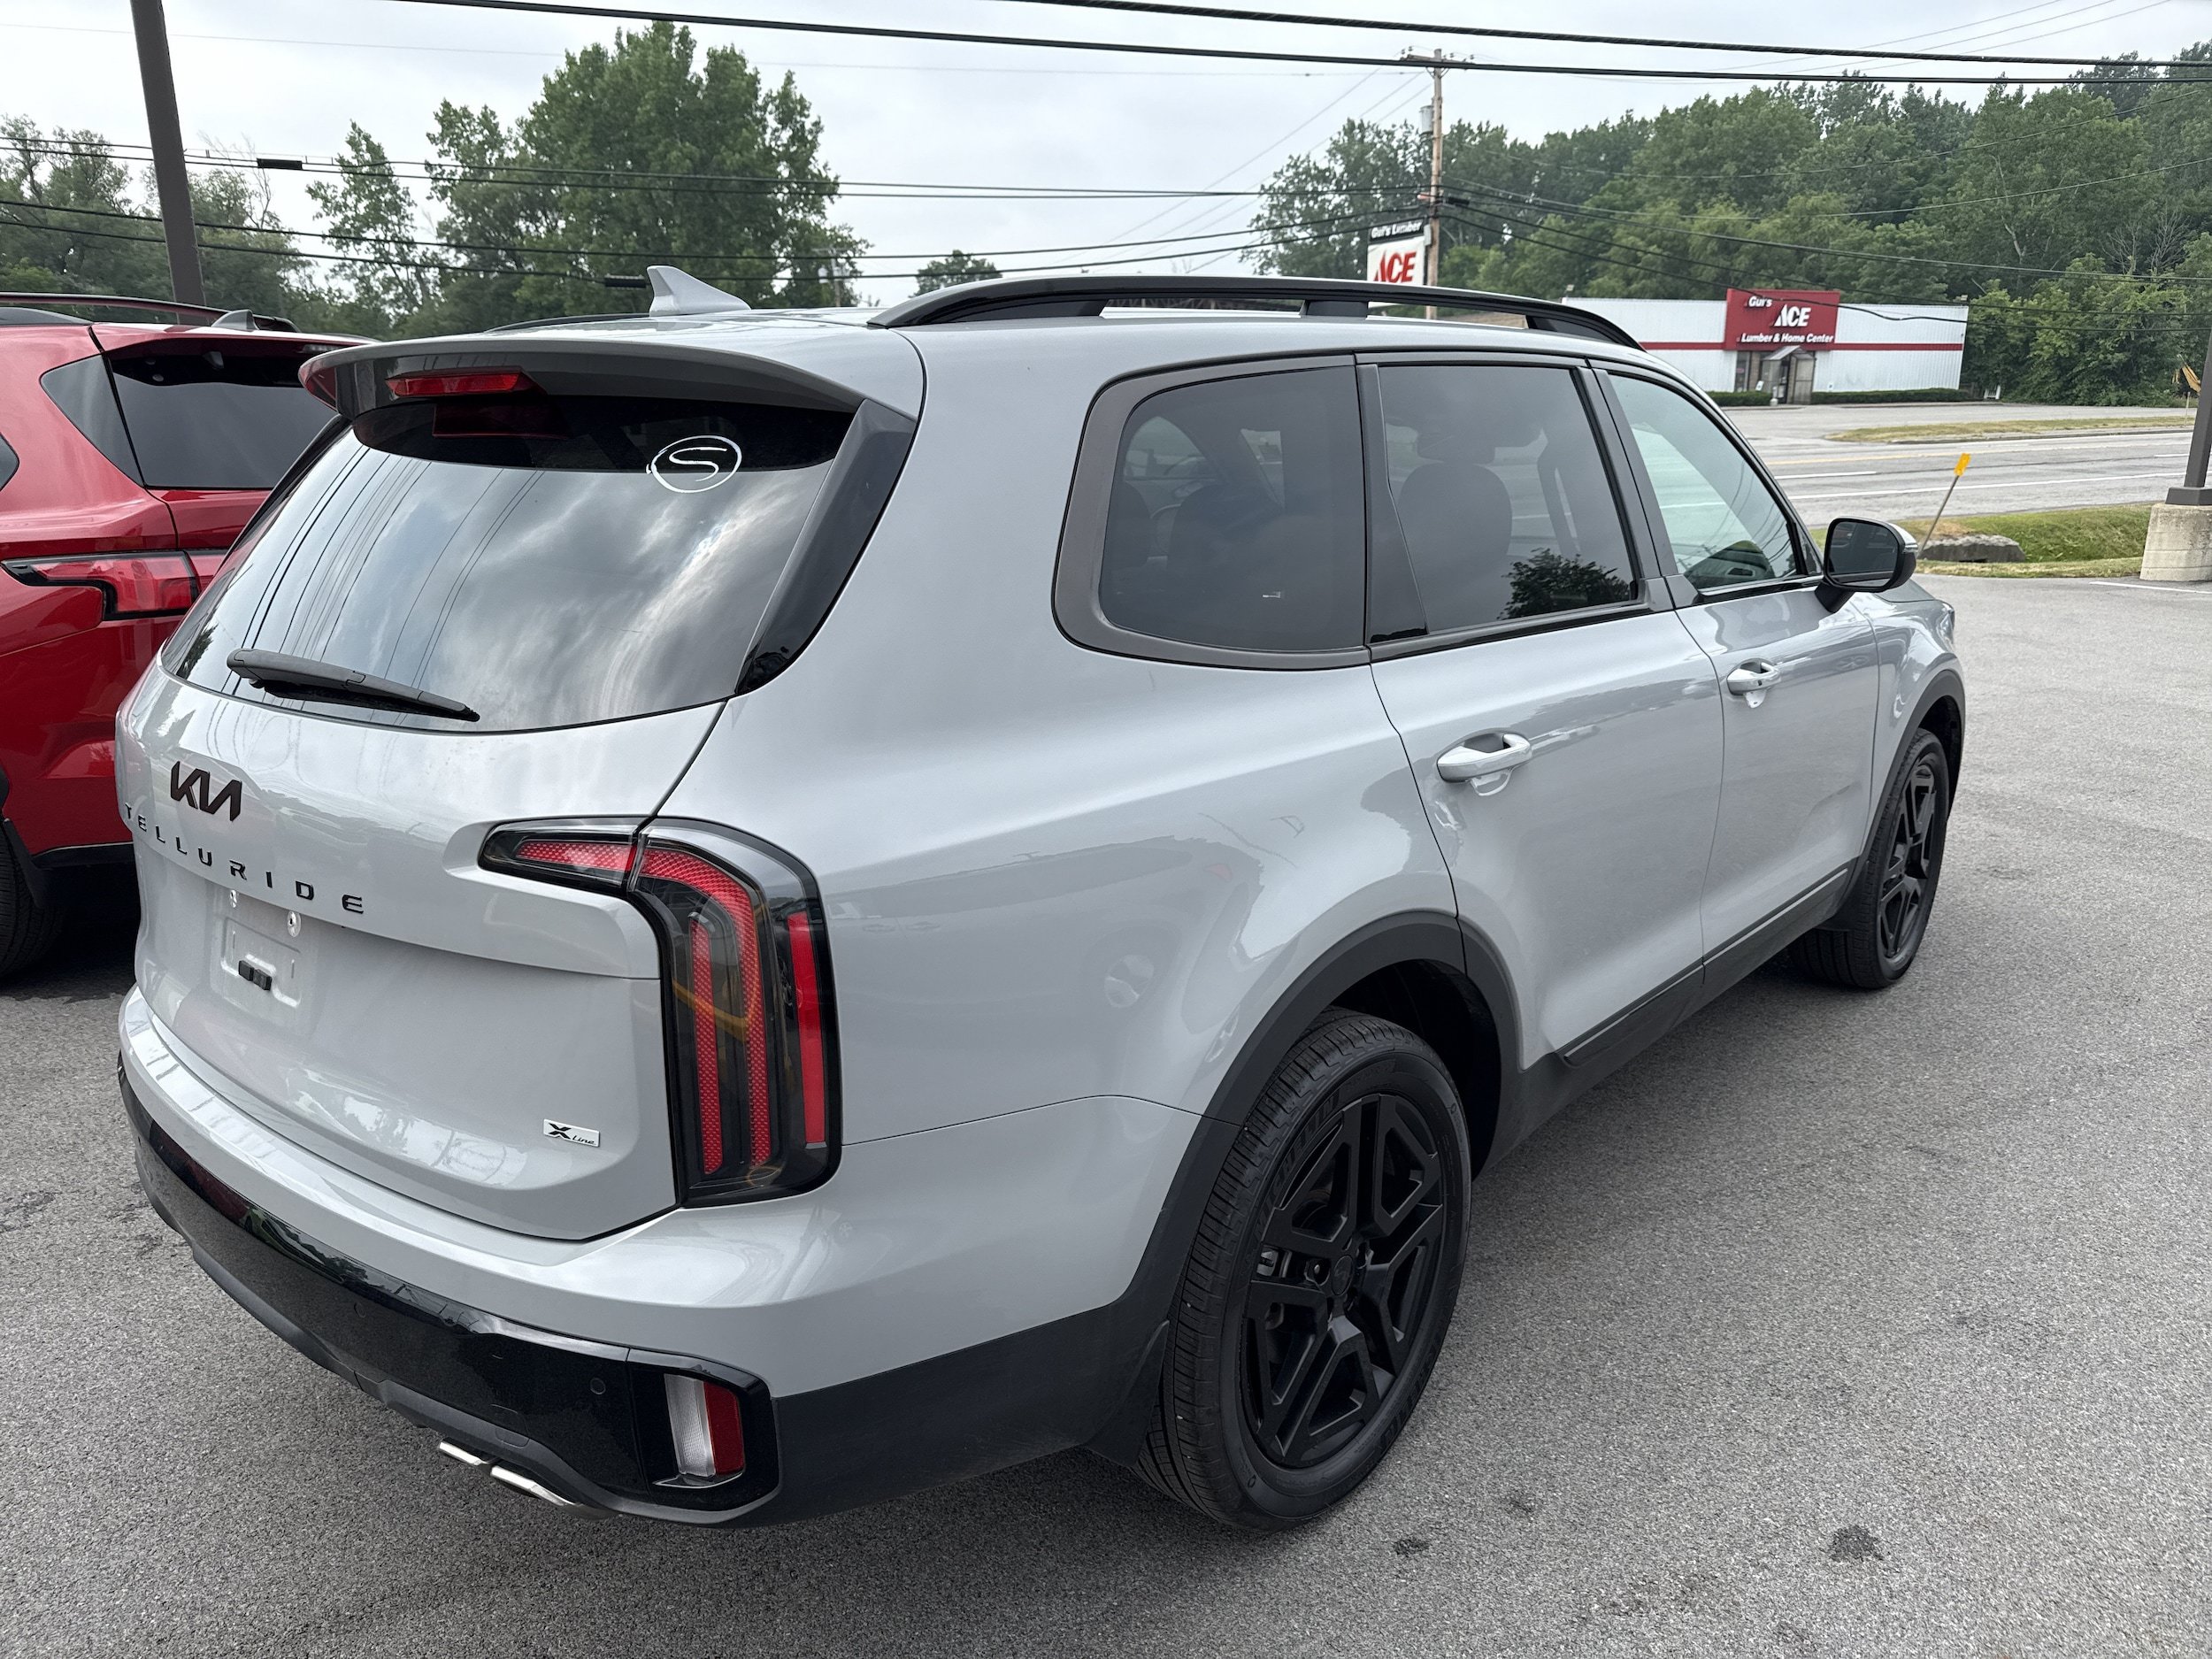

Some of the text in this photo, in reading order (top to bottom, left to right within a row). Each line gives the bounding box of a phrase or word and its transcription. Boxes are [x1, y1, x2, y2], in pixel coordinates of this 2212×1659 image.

[1392, 220, 1423, 234] Lumber
[1373, 249, 1417, 283] ACE
[1774, 304, 1811, 326] ACE
[1741, 333, 1834, 343] Lumber & Home Center
[125, 803, 364, 914] TELLURIDE
